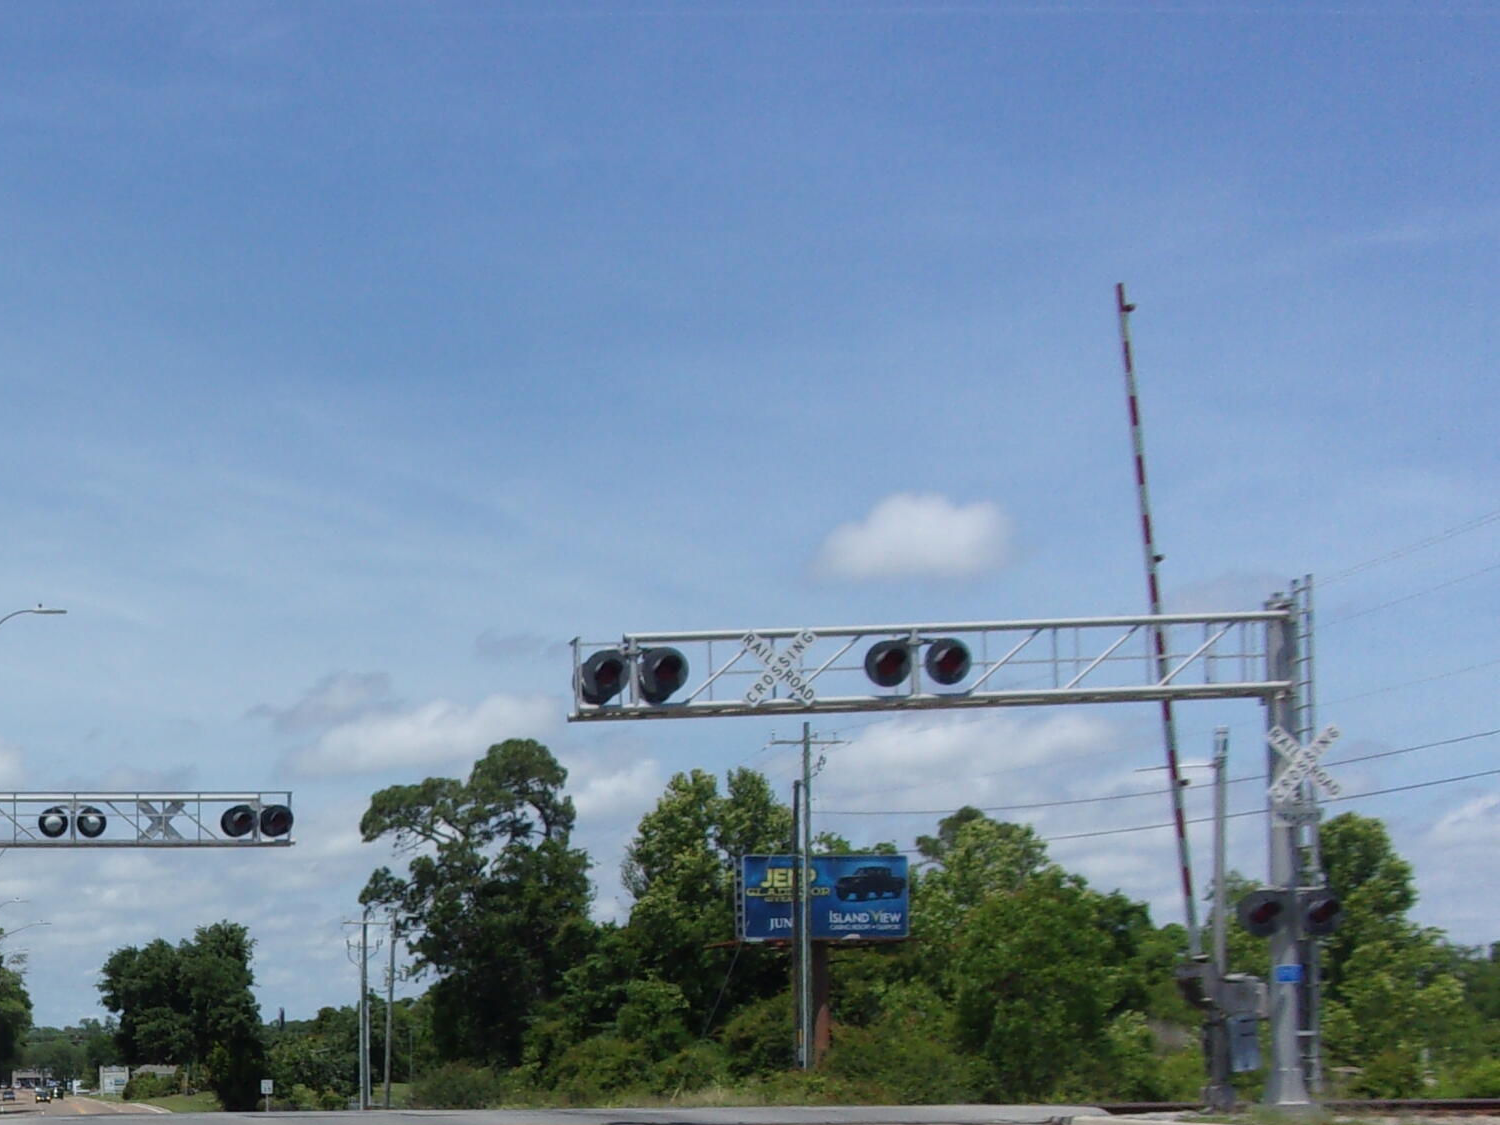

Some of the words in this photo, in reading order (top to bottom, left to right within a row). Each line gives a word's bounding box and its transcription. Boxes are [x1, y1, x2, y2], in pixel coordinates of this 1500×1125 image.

[746, 632, 814, 703] CROSSING
[769, 917, 794, 931] JUN
[828, 910, 870, 924] ISLAND
[869, 909, 902, 923] VIEW
